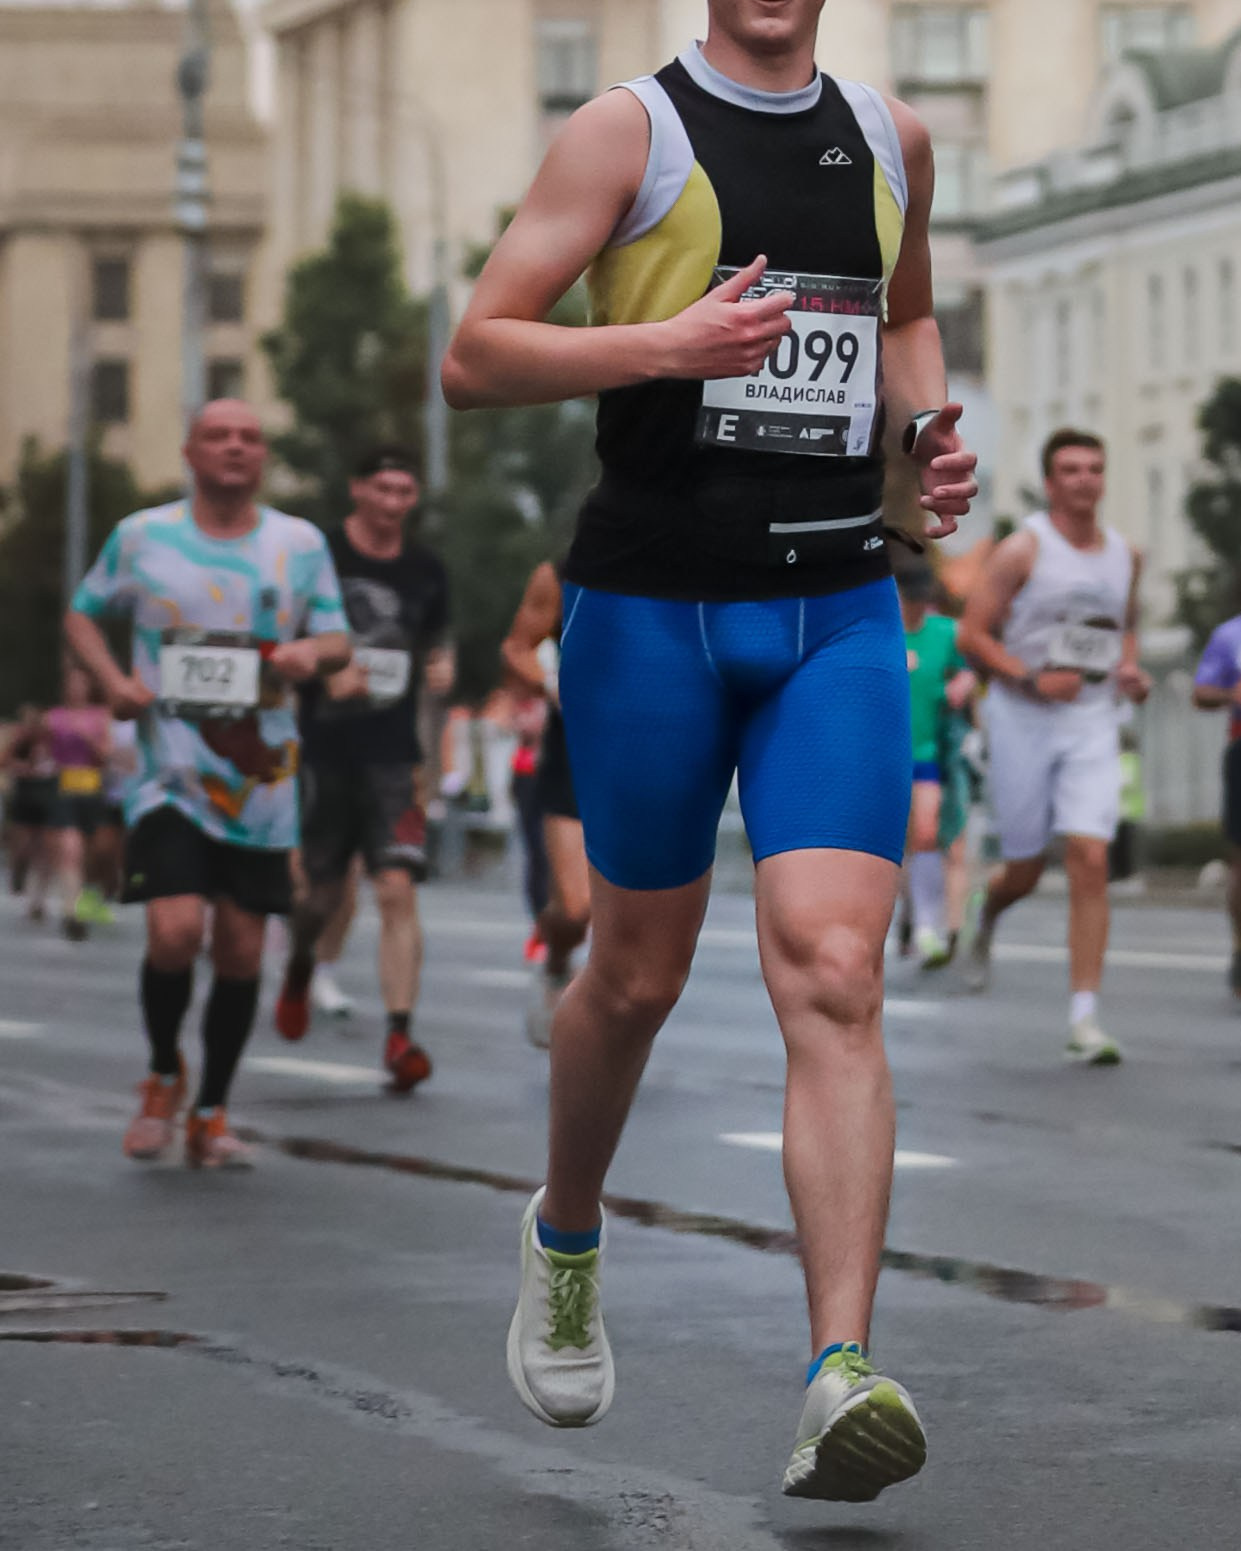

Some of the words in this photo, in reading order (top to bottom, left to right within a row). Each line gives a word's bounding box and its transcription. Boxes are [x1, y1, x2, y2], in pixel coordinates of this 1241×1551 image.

[750, 329, 859, 383] 099
[745, 383, 845, 404] ВЛАДИСЛАВ
[181, 655, 235, 684] 702
